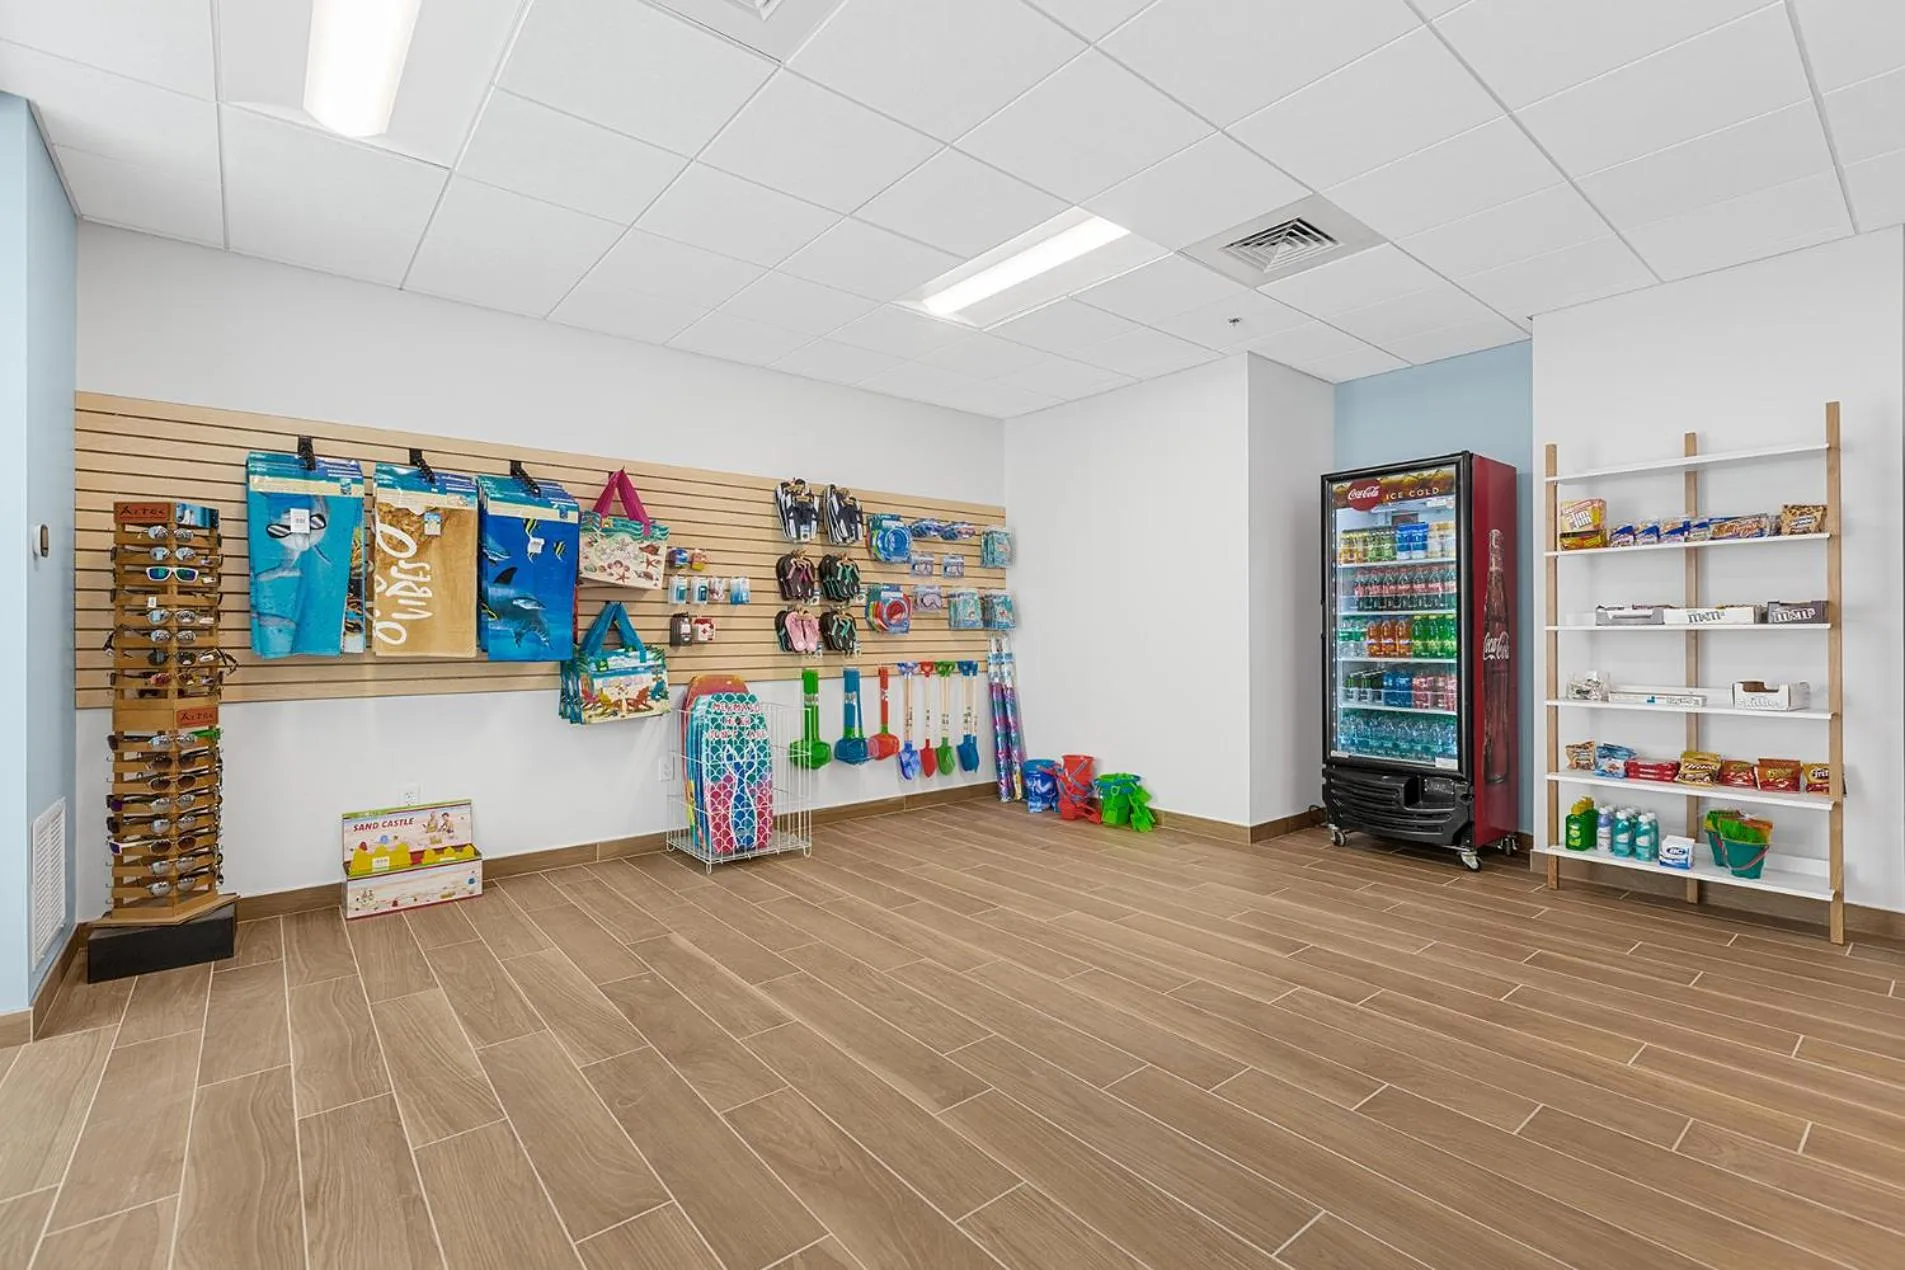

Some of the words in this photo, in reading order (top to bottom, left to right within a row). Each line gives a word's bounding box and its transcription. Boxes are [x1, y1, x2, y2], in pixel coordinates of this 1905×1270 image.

[1348, 486, 1380, 500] Coca-Cola
[1386, 491, 1404, 500] ICE
[1409, 487, 1440, 498] COLD
[353, 822, 379, 832] SAND
[381, 817, 414, 828] CASTLE
